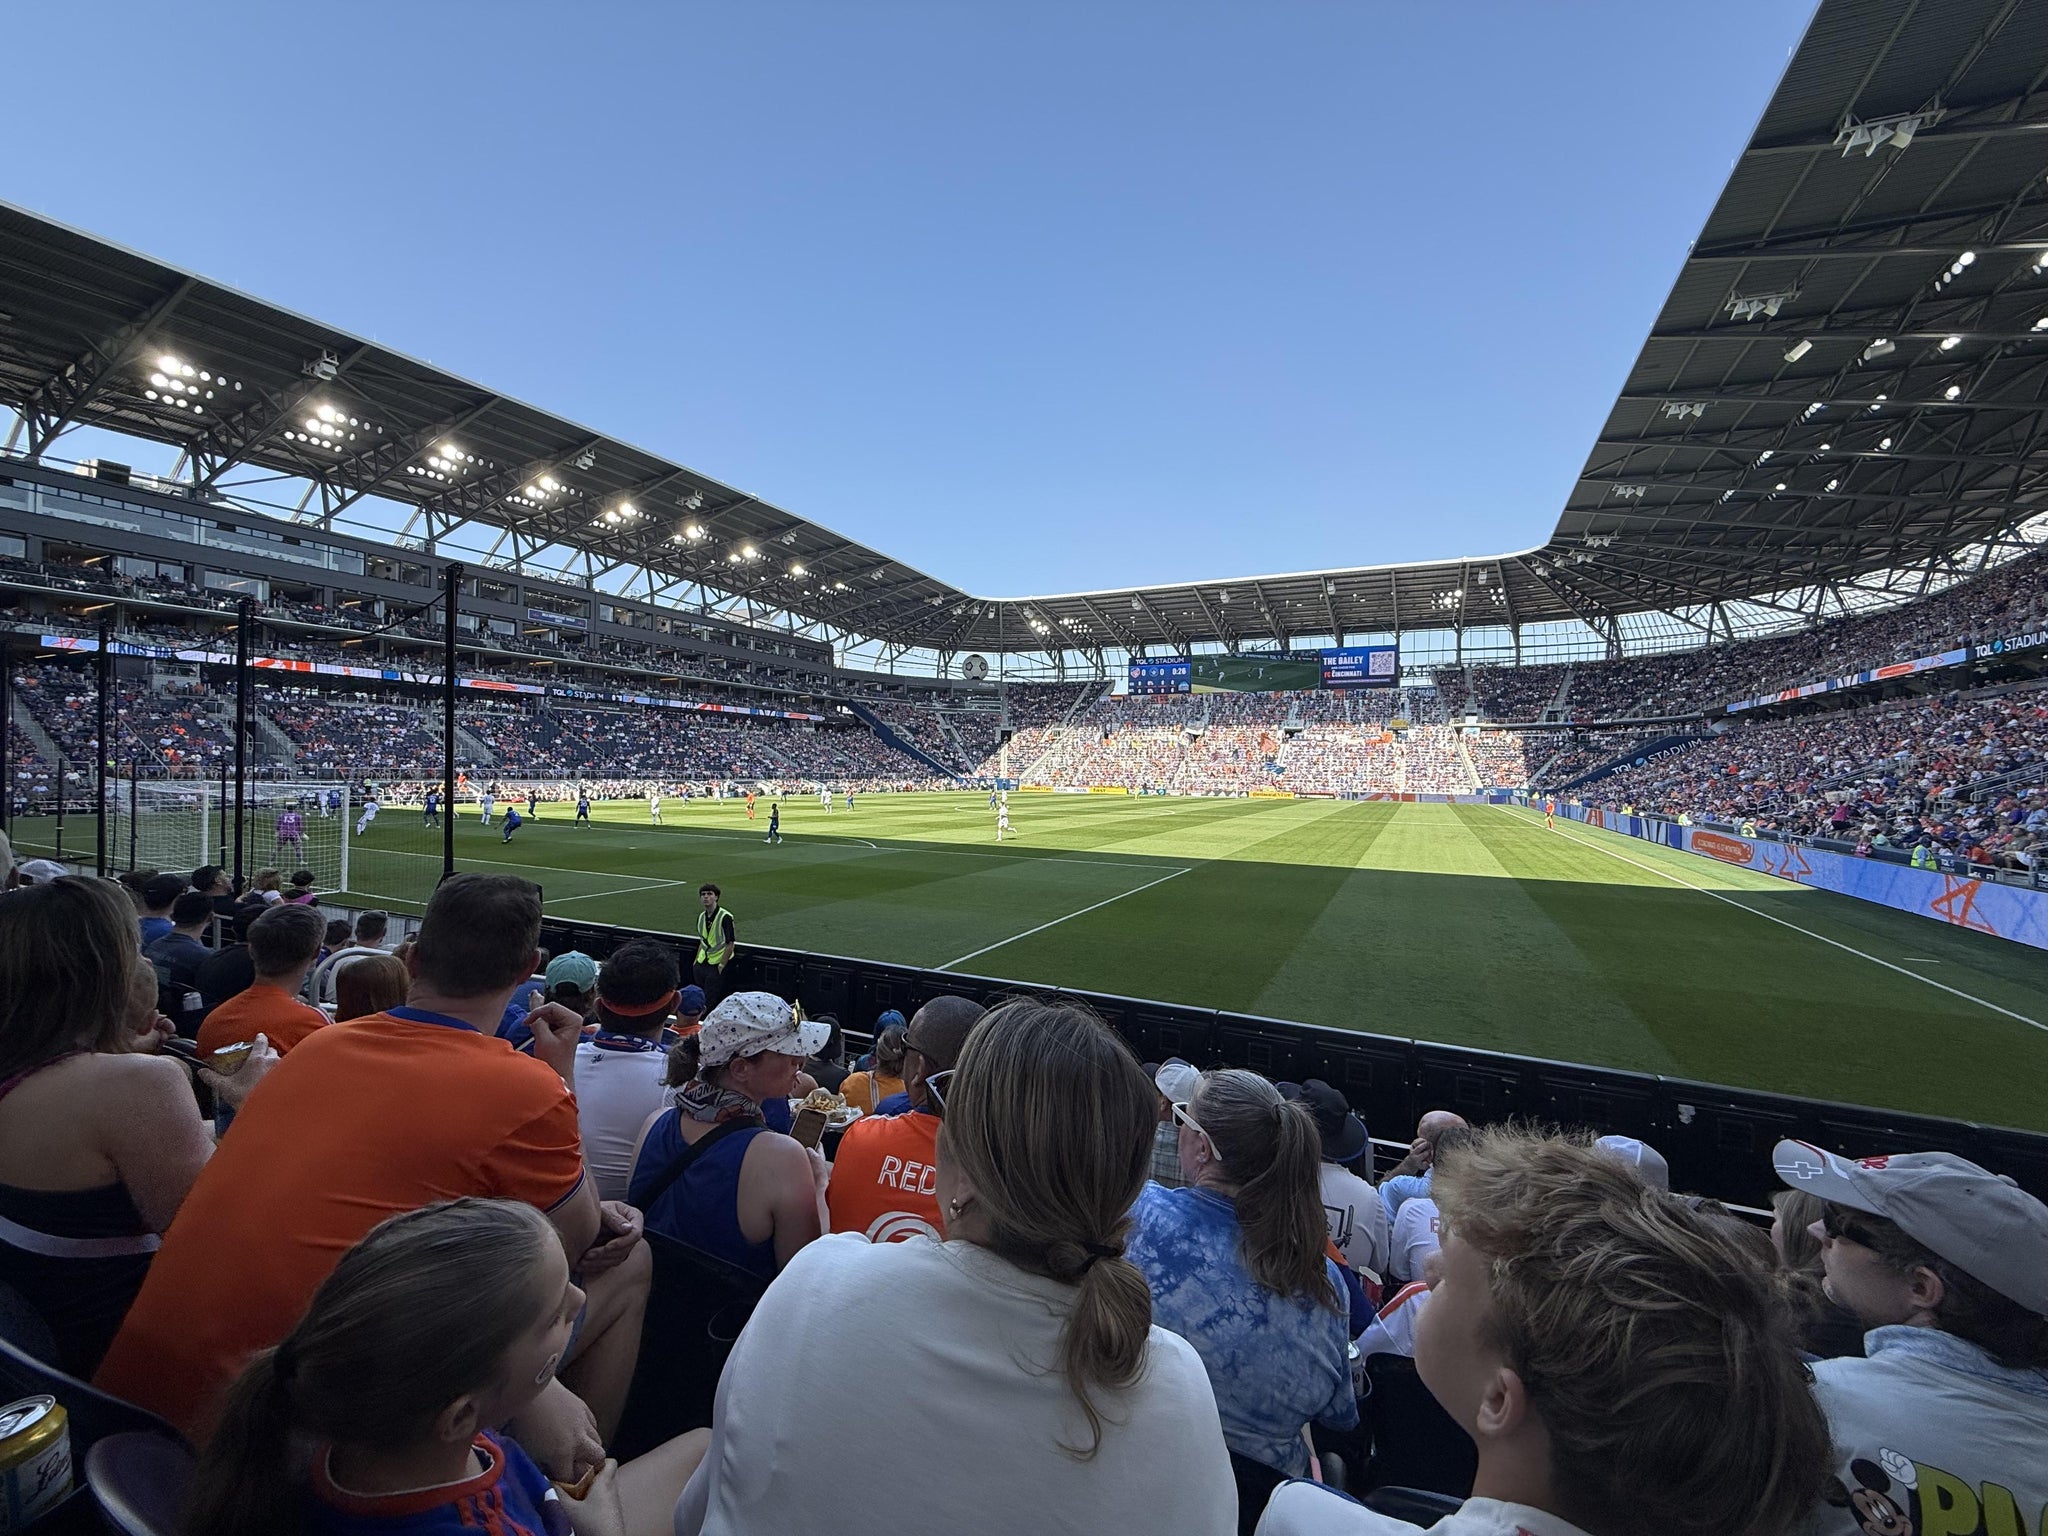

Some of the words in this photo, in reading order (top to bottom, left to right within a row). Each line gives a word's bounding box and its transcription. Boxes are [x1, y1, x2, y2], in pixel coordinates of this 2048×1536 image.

[1975, 644, 1994, 658] TQL
[2004, 630, 2048, 651] STADIUM
[1323, 657, 1337, 665] THE
[1338, 655, 1364, 665] BAILEY
[1172, 667, 1186, 675] 0:26
[552, 688, 566, 696] TQL
[1648, 738, 1702, 763] STADIUM
[877, 1155, 937, 1195] RED
